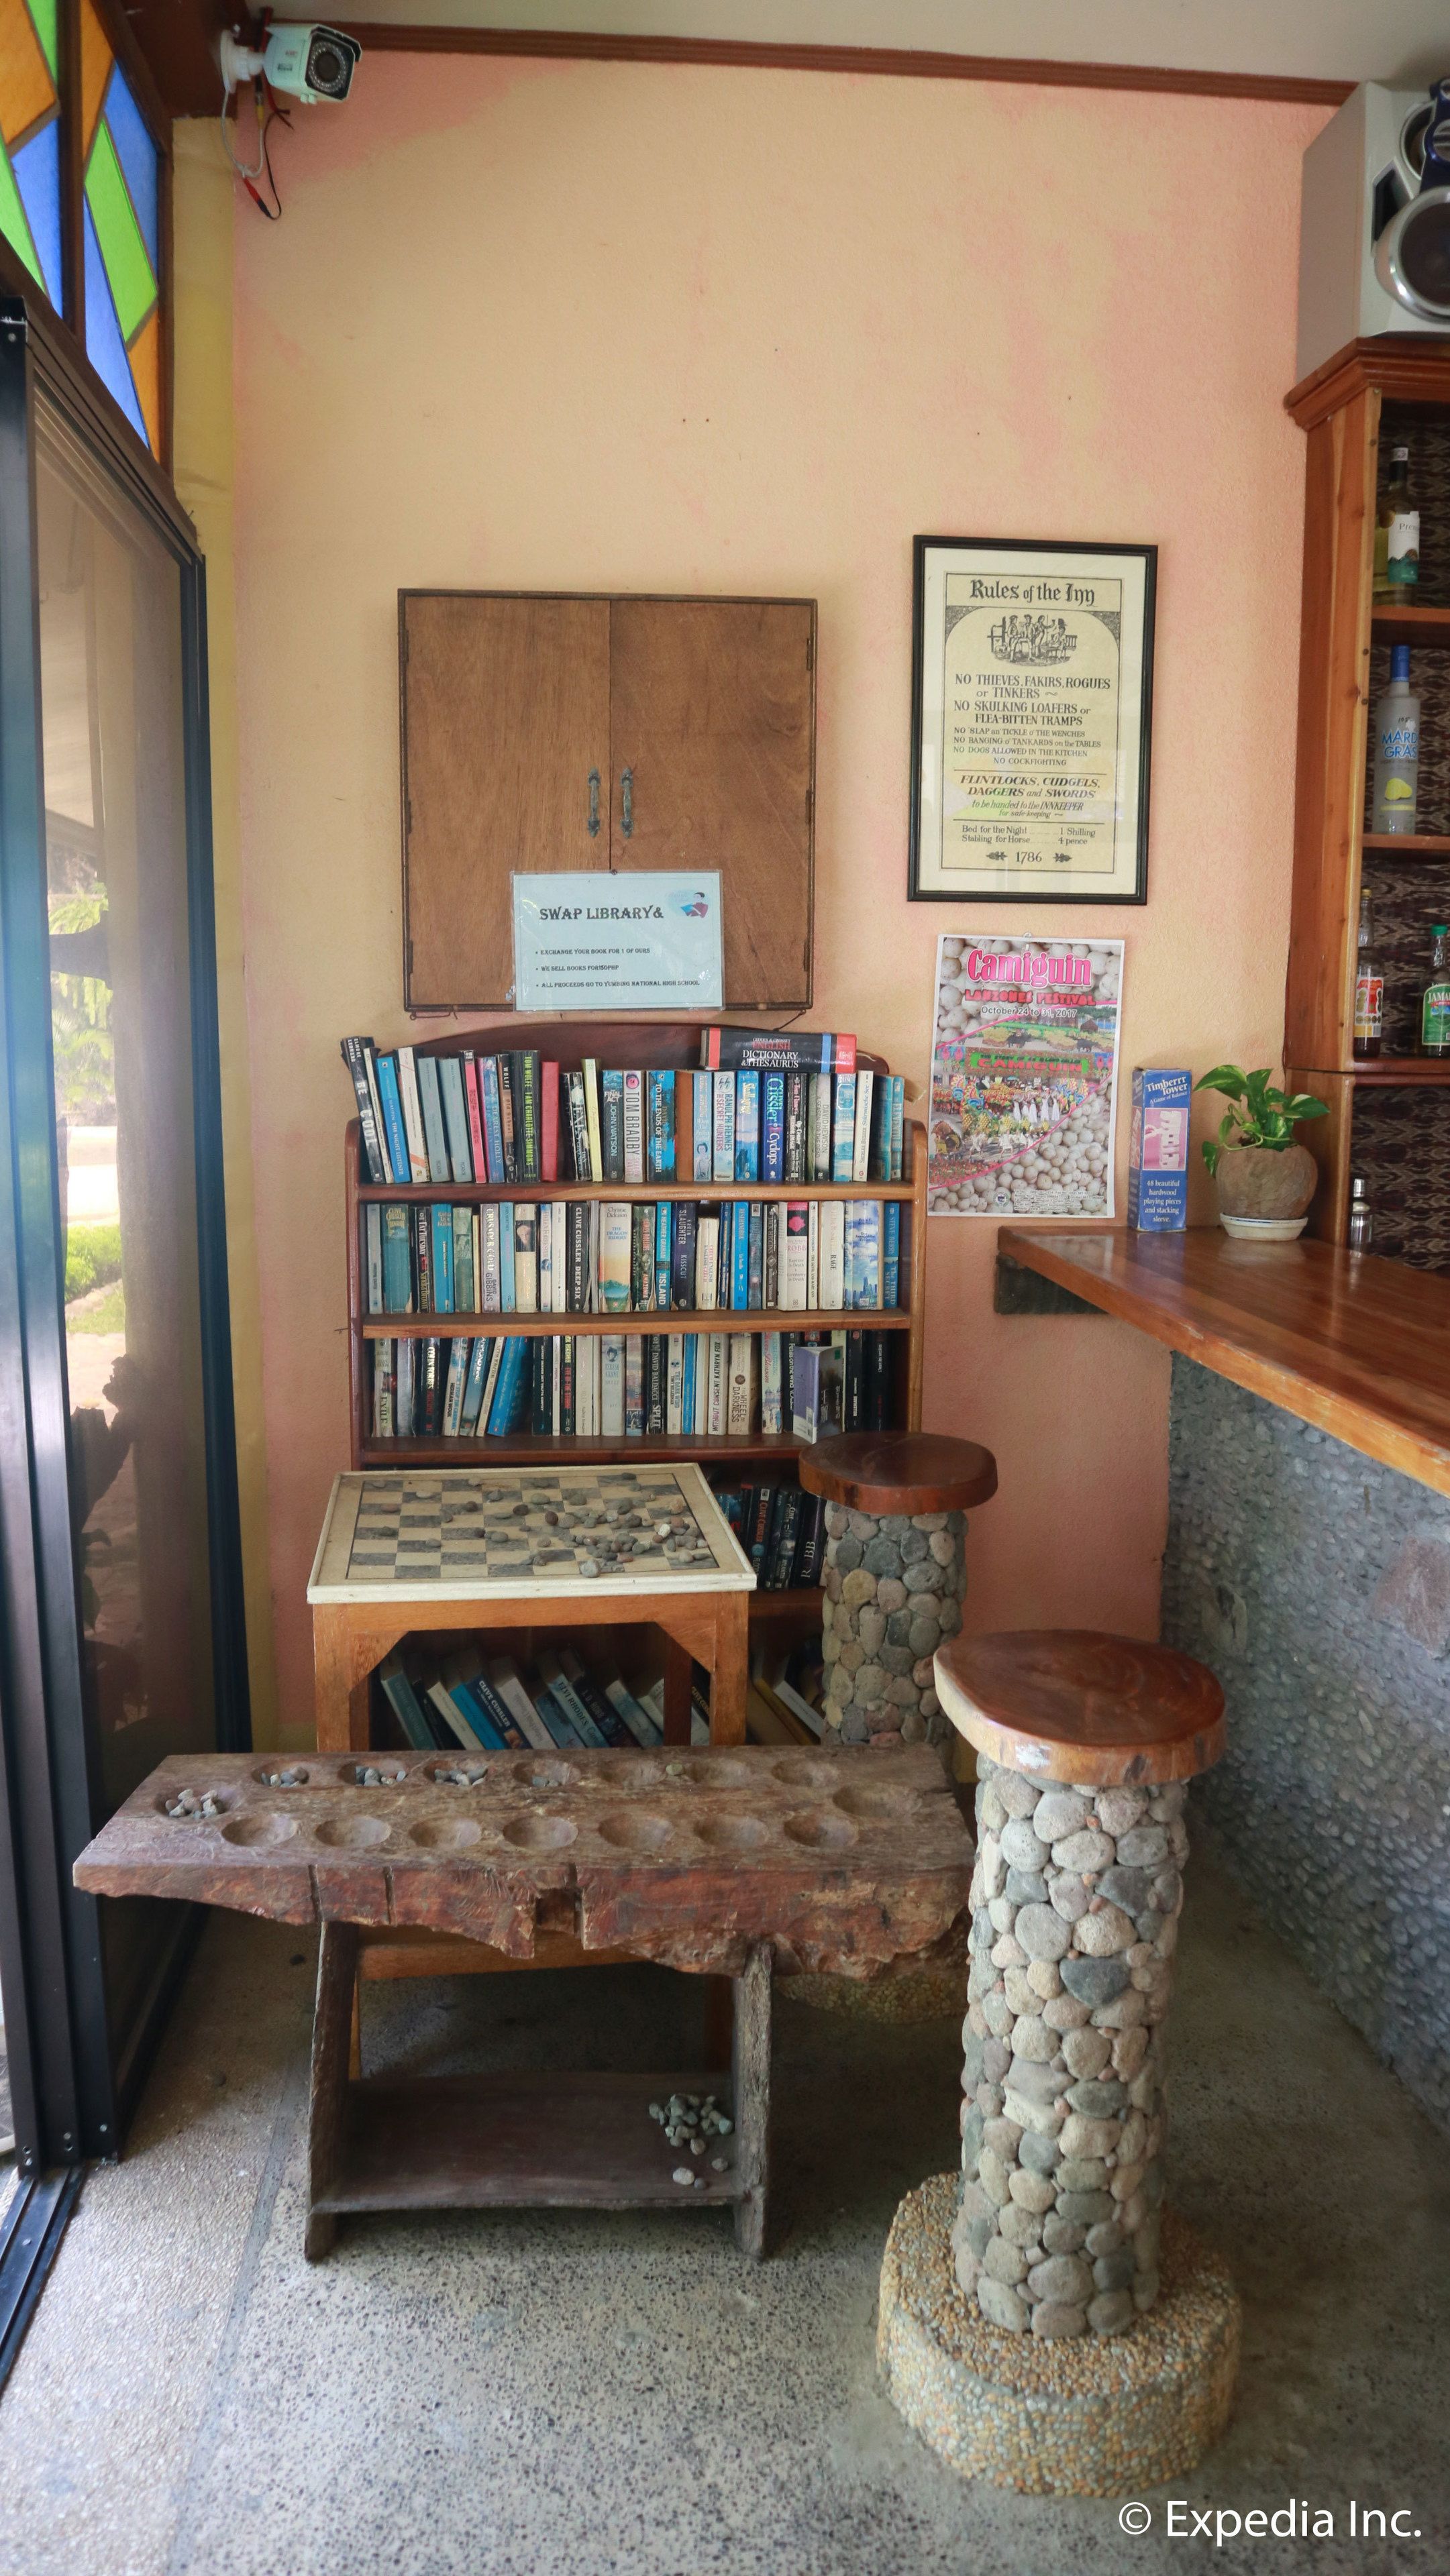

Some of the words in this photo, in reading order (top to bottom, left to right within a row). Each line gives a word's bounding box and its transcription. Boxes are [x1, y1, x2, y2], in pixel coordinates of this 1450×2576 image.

[970, 579, 1019, 599] Rules
[1023, 586, 1034, 603] of
[1037, 582, 1061, 600] the
[1066, 583, 1098, 607] Inn
[955, 674, 971, 684] NO
[976, 675, 1023, 687] THIEVES,
[1025, 676, 1065, 688] FAKIRS,
[1066, 678, 1110, 689] ROGUES
[992, 688, 1040, 699] TINKERS
[954, 701, 970, 711] NO
[975, 701, 1027, 713] SKULKING
[1031, 704, 1078, 714] LOAFERS
[975, 714, 1038, 725] FLEA-BITTEN
[1041, 716, 1082, 726] TRAMPS
[1003, 729, 1027, 737] TICKLE
[1013, 739, 1053, 747] TANKARDS
[990, 747, 1027, 756] ALLOWED
[1055, 750, 1088, 758] KITCHEN
[1384, 745, 1418, 758] GRAS
[1008, 758, 1067, 766] COCKFIGHTING
[960, 775, 1039, 787] FLINTLOCKS,
[1042, 777, 1100, 789] CUDGELS,
[968, 787, 1025, 797] DAGGERS
[1026, 788, 1042, 797] and
[1045, 789, 1096, 799] SWORDS
[991, 800, 1021, 809] handed
[1040, 802, 1084, 811] INNKEEPER
[962, 825, 978, 833] Bed
[993, 826, 1005, 834] the
[1006, 826, 1027, 836] Night
[1067, 828, 1096, 838] Shilling
[962, 835, 992, 845] Stabling
[1016, 851, 1043, 864] 1786
[539, 906, 582, 920] SWAP
[967, 948, 1092, 989] Camiguin
[981, 1006, 1016, 1015] October
[1018, 1008, 1029, 1016] 24
[1030, 1008, 1039, 1016] to
[1041, 1009, 1054, 1018] 31,
[1056, 1009, 1078, 1018] 2017
[752, 1040, 790, 1051] ENGLISH
[743, 1050, 798, 1060] DICTIONARY
[524, 1056, 532, 1069] TOM
[978, 1058, 1082, 1072] CAMIGUIN
[524, 1069, 533, 1088] WOLFE
[1145, 1075, 1186, 1092] Timberrr
[604, 1090, 622, 1099] FINAL
[655, 1083, 662, 1092] TO
[1161, 1083, 1188, 1096] Tower
[626, 1091, 640, 1112] TOM
[766, 1077, 784, 1122] Cussler
[716, 1099, 724, 1122] SECRET
[724, 1093, 733, 1123] RANULPH
[525, 1106, 533, 1137] CHARLOTTE
[393, 1133, 401, 1150] NIGHT
[626, 1116, 640, 1155] BRADBY
[716, 1124, 724, 1152] HUNTERS
[724, 1125, 733, 1152] FIENNES
[495, 1140, 503, 1165] HOLLY
[525, 1138, 533, 1167] SIMMONS
[767, 1132, 780, 1165] Cyclops
[1155, 1179, 1180, 1188] beautiful
[1149, 1188, 1177, 1196] hardwood
[1143, 1197, 1164, 1206] playing
[1165, 1197, 1182, 1206] pieces
[1156, 1207, 1180, 1215] stacking
[678, 1210, 687, 1245] SLAUGHTER
[658, 1275, 666, 1305] ISLAND
[652, 1352, 660, 1371] DAVID
[652, 1372, 660, 1401] BALDACCI
[731, 1386, 739, 1423] DARKNESS
[739, 1394, 747, 1417] WHEEL
[652, 1404, 662, 1429] SPLIT
[478, 1680, 495, 1701] CLIVE
